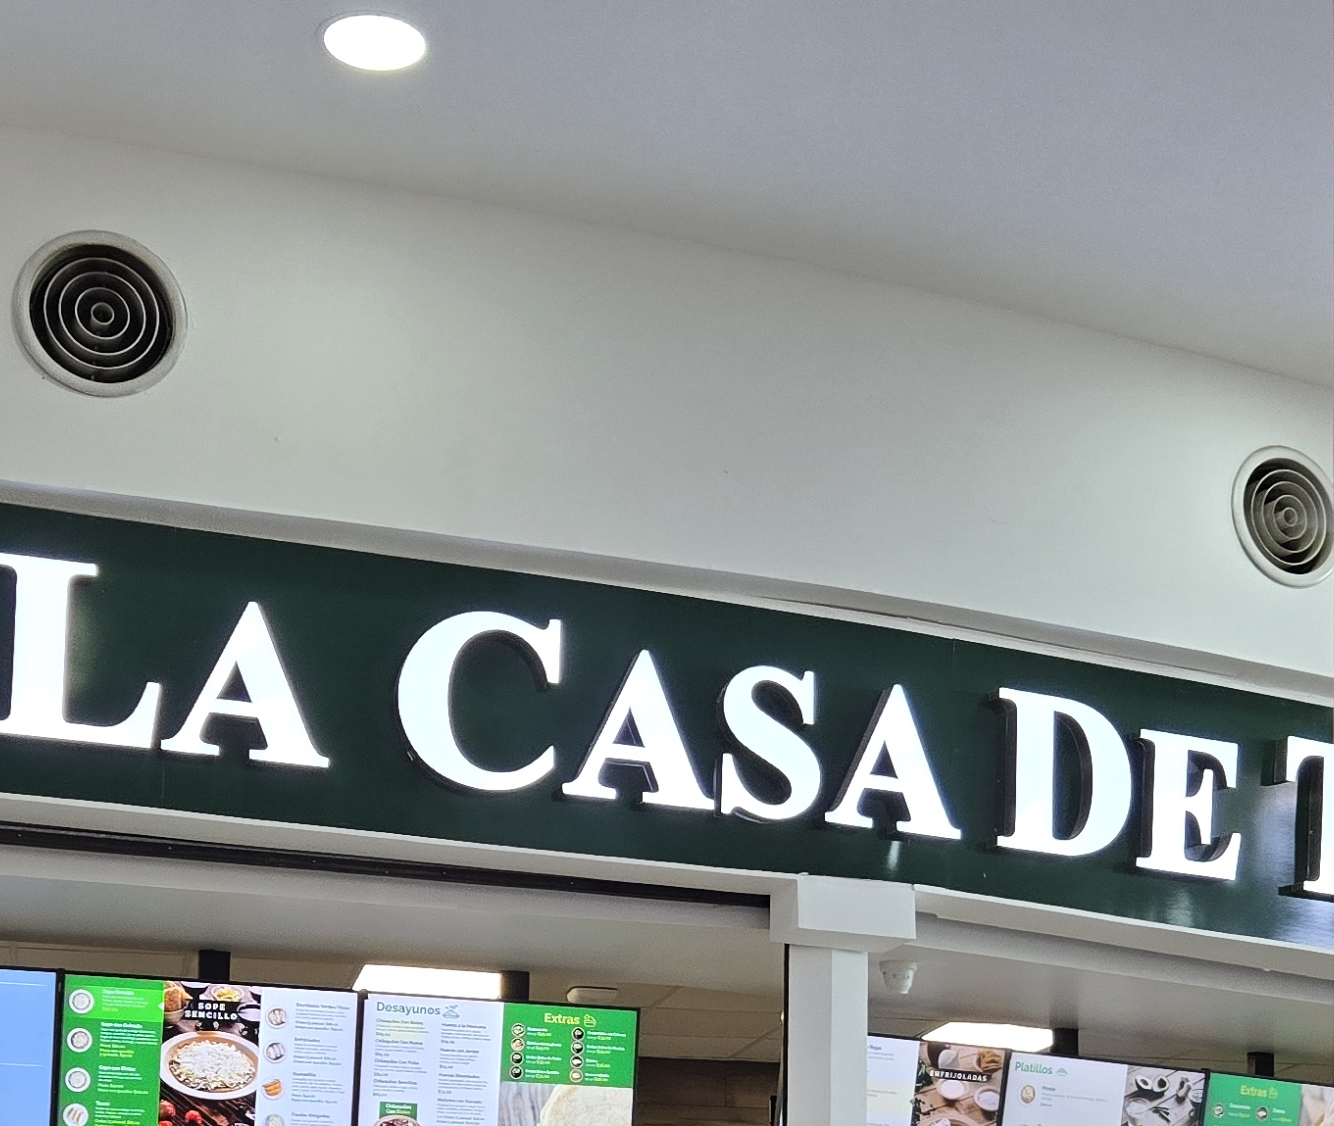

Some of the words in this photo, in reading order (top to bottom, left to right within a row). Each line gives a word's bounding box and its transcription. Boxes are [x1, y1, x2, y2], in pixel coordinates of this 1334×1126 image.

[397, 609, 961, 841] CASA
[995, 687, 1241, 882] DE
[376, 1001, 441, 1016] Desayunos
[544, 1012, 580, 1025] Extras
[1014, 1061, 1053, 1075] Platillos
[929, 1069, 987, 1082] ENFRIJOLADAS
[1240, 1085, 1267, 1098] Extras
